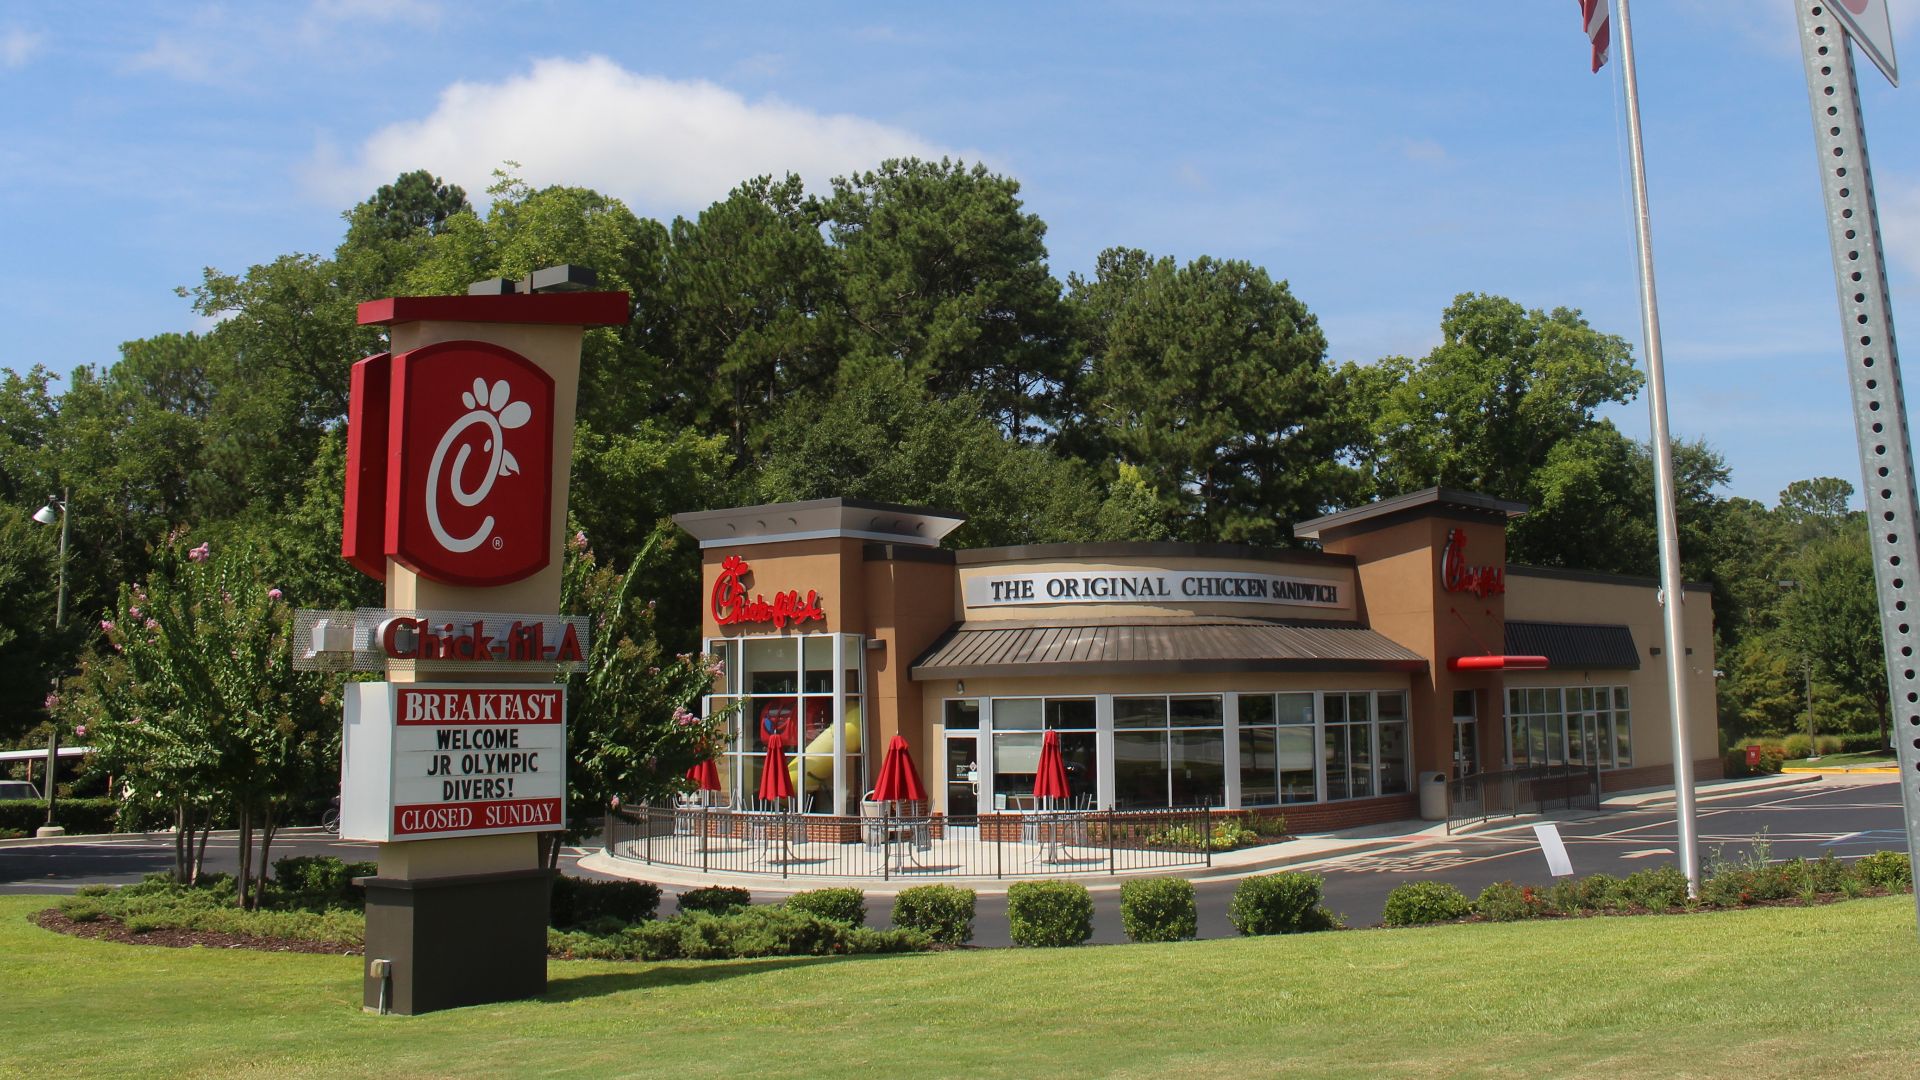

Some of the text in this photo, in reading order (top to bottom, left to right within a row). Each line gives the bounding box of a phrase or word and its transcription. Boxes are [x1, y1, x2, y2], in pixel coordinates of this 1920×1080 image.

[991, 577, 1338, 603] THE ORIGINAL CHICKEN SANDWICH
[383, 617, 585, 661] Chick-fil-A
[405, 692, 556, 721] BREAKFAST
[436, 729, 519, 750] WELCOME
[427, 752, 538, 776] JR OLYMPIC
[443, 778, 514, 801] DIVERS!
[401, 803, 554, 831] CLOSED SUNDAY
